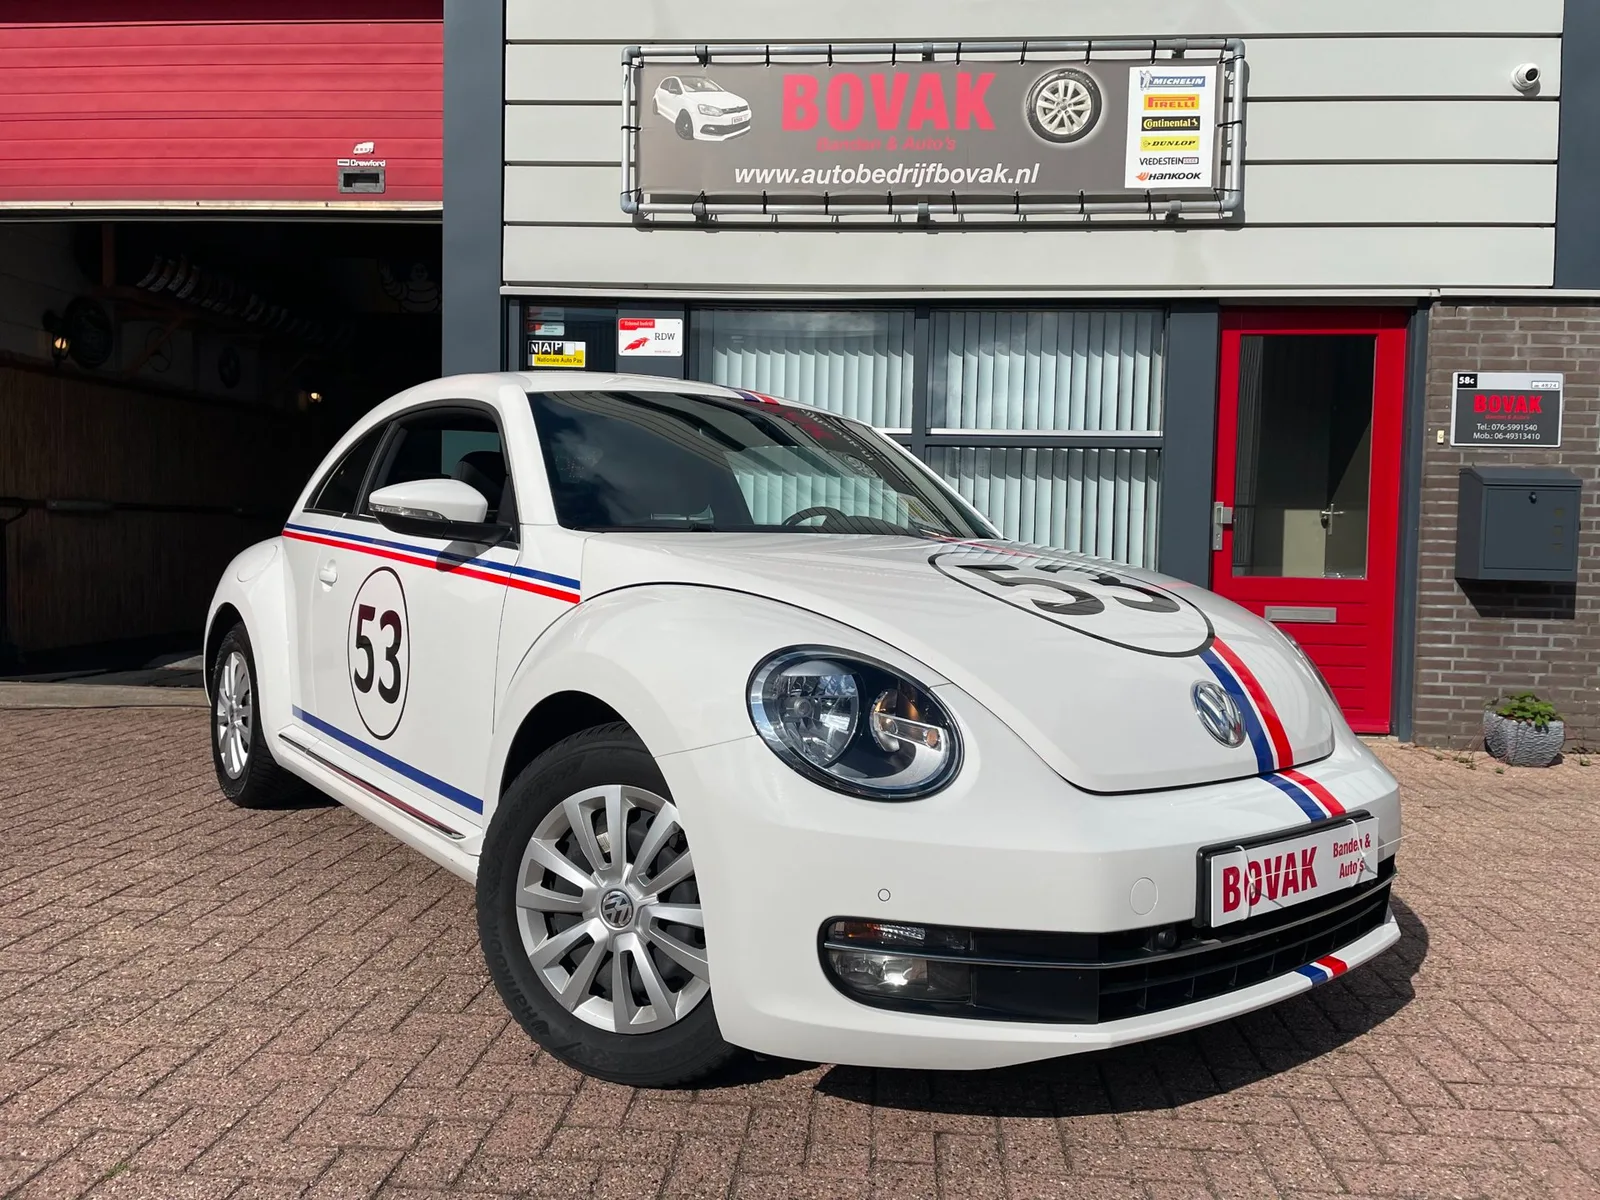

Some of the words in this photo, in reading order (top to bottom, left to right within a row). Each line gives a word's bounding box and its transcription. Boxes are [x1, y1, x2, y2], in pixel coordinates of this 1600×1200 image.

[1153, 77, 1203, 85] MICHELIN
[781, 72, 996, 132] BOVAK
[1148, 96, 1196, 108] PIRELLI
[1143, 118, 1191, 129] Continental
[816, 136, 881, 152] Banden
[886, 136, 898, 151] &
[902, 136, 957, 151] Auto's
[1139, 157, 1184, 165] VREDESTEIN
[735, 163, 1040, 187] www.autobedrijfbovak.nl
[654, 332, 676, 341] RDW
[530, 341, 563, 353] NAP
[1458, 376, 1475, 385] 58c
[1473, 394, 1543, 414] BOVAK
[1476, 423, 1491, 431] Tel.:
[1491, 423, 1538, 431] 076-5991540
[1493, 432, 1541, 440] 06-49313410
[954, 564, 1181, 616] 53
[354, 603, 402, 704] 53
[1332, 836, 1363, 858] Banden
[1364, 833, 1371, 848] &
[1339, 858, 1364, 879] Auto's
[1222, 846, 1318, 914] BOVAK
